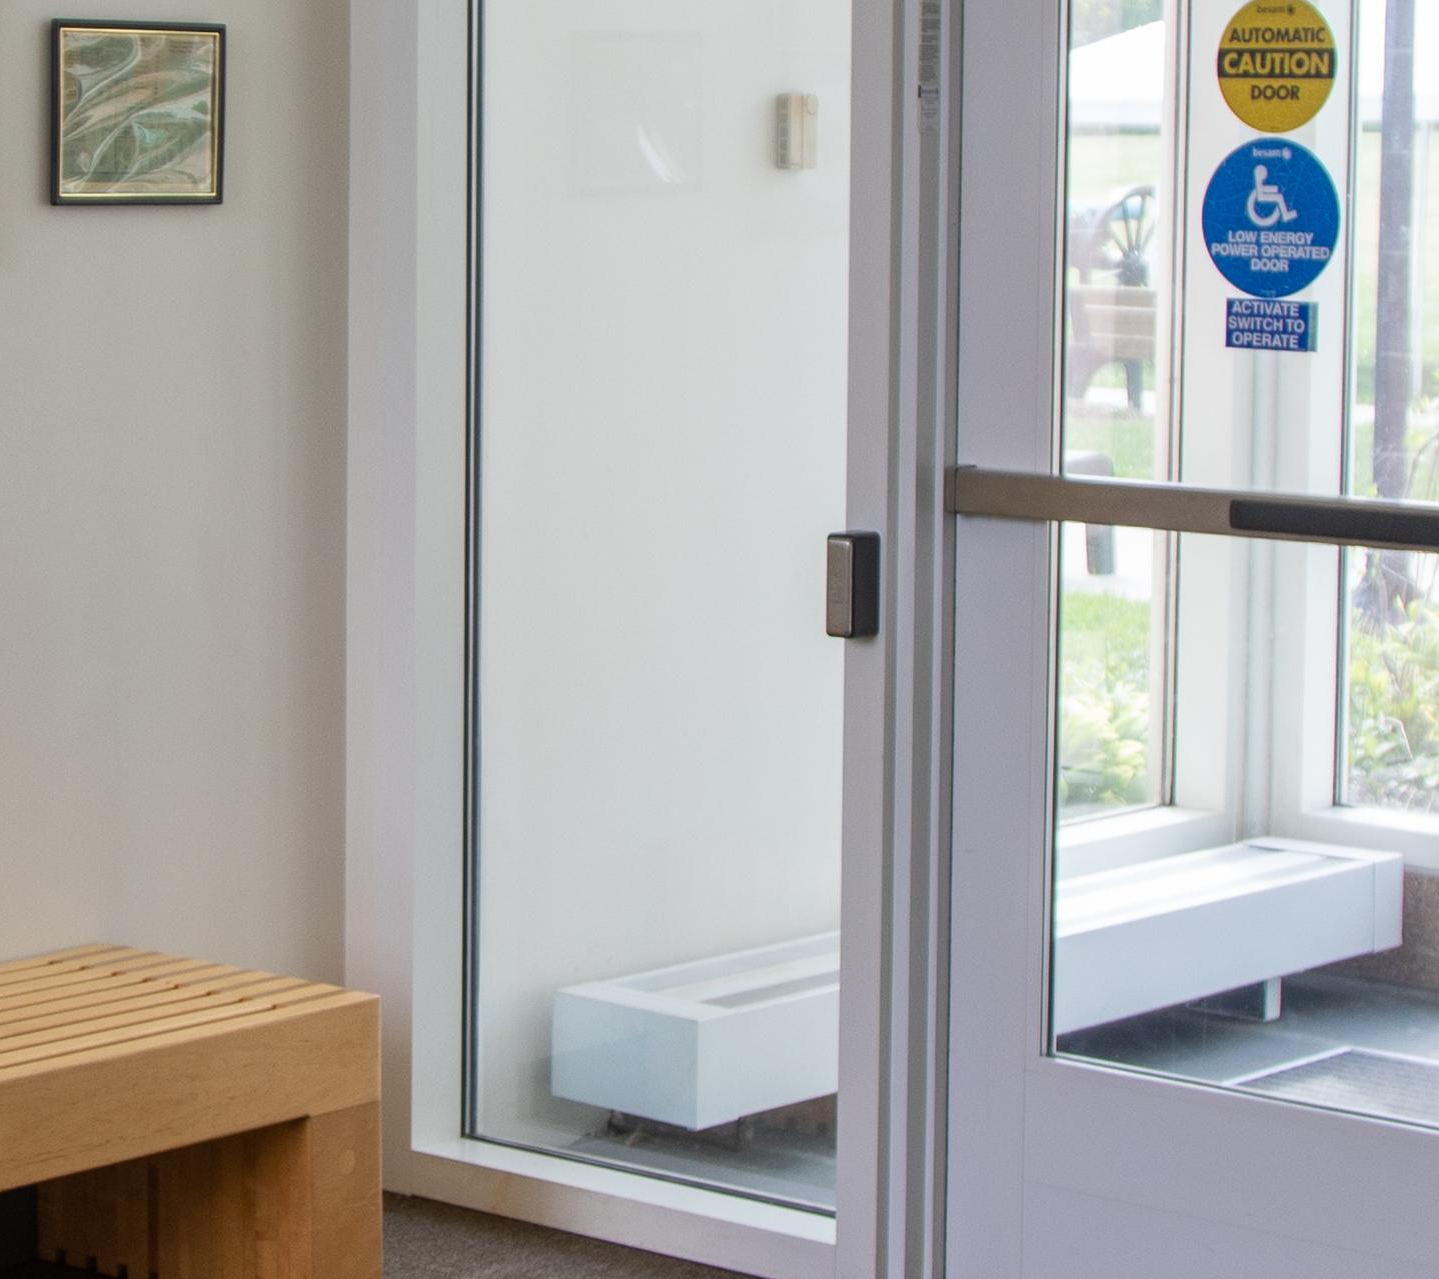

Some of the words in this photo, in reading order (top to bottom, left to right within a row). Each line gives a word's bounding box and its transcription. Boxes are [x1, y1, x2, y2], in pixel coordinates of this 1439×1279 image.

[1229, 27, 1325, 43] AUTOMATIC
[1223, 51, 1330, 75] CAUTION
[1250, 84, 1300, 100] DOOR
[1253, 148, 1281, 159] besam
[1228, 230, 1257, 243] LOW
[1260, 231, 1314, 245] ENERGY
[1211, 245, 1258, 257] POWER
[1262, 245, 1330, 260] OPERATED
[1250, 259, 1289, 273] DOOR
[1232, 301, 1300, 317] ACTIVATE
[1228, 316, 1284, 331] SWITCH
[1286, 317, 1305, 332] TO
[1232, 333, 1300, 348] OPERATE
